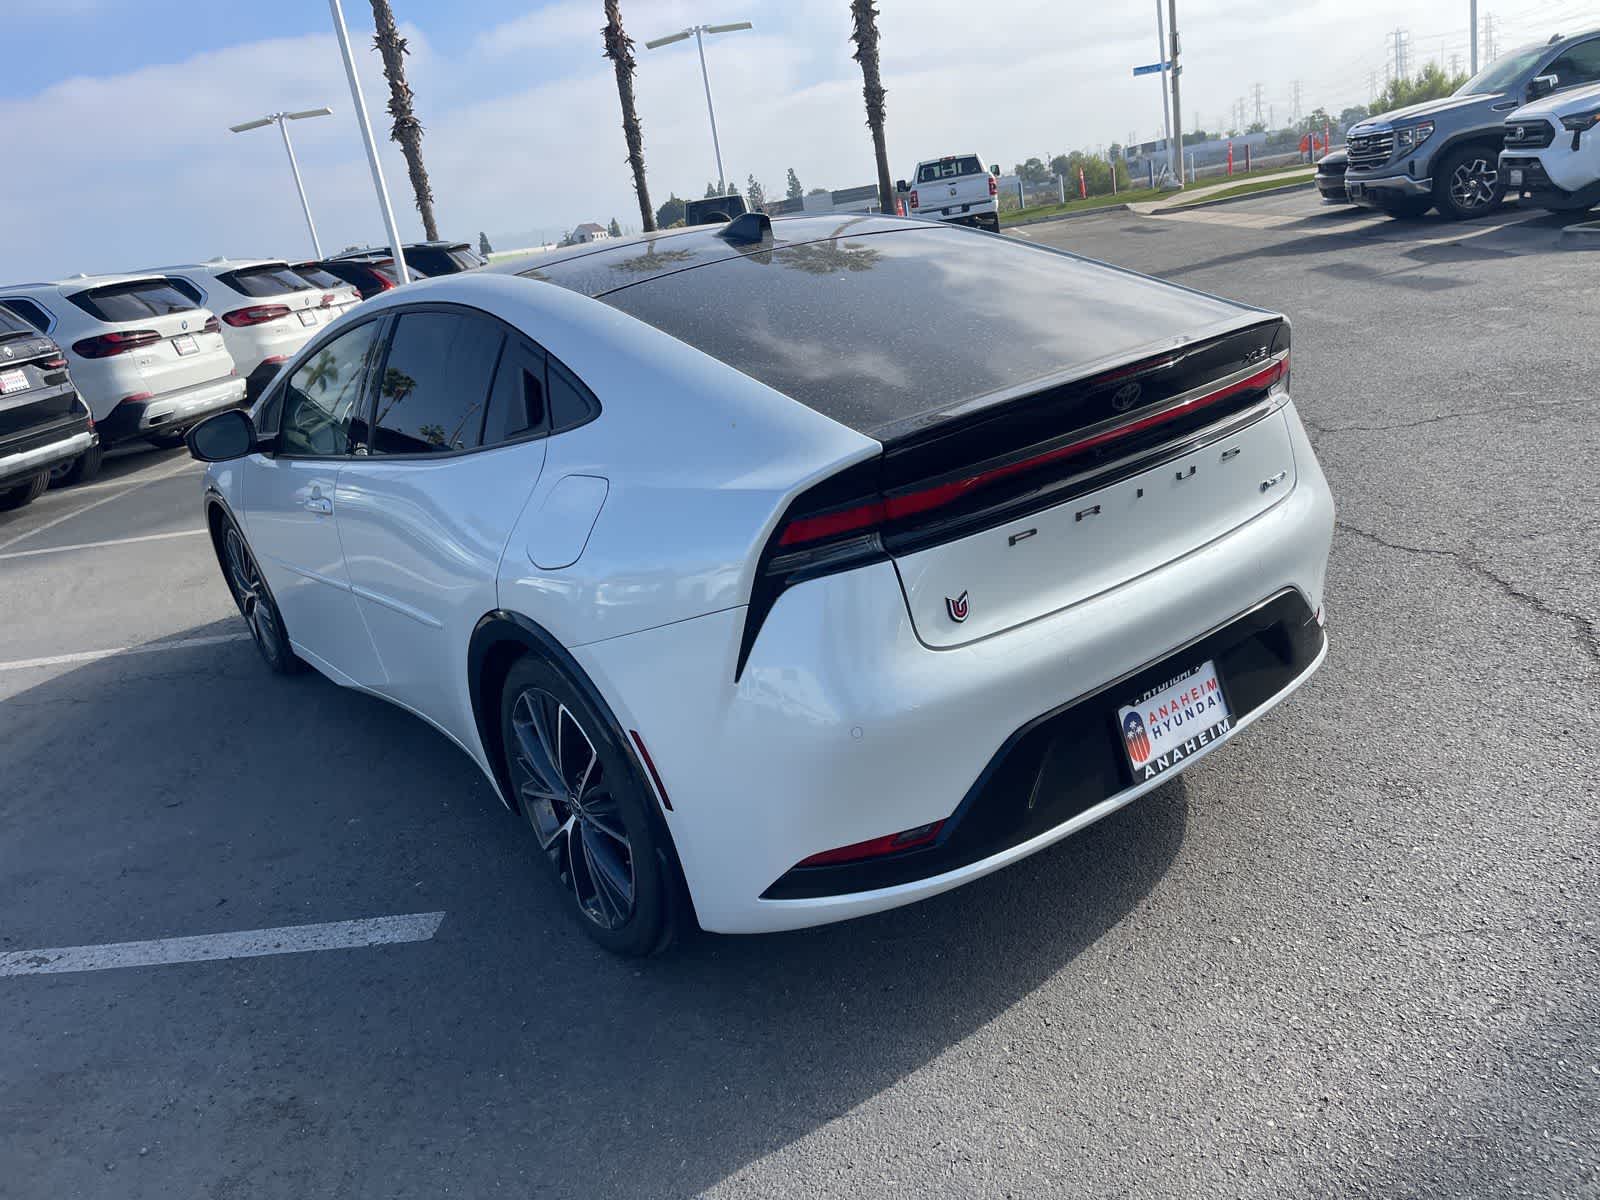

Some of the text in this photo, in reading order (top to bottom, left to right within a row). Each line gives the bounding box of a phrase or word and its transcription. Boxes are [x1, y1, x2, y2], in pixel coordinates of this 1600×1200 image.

[1008, 446, 1241, 547] PRIUS
[1148, 677, 1218, 726] ANAHEIM
[1152, 691, 1223, 740] HYUNDAI
[1144, 718, 1231, 780] ANAHEIM
